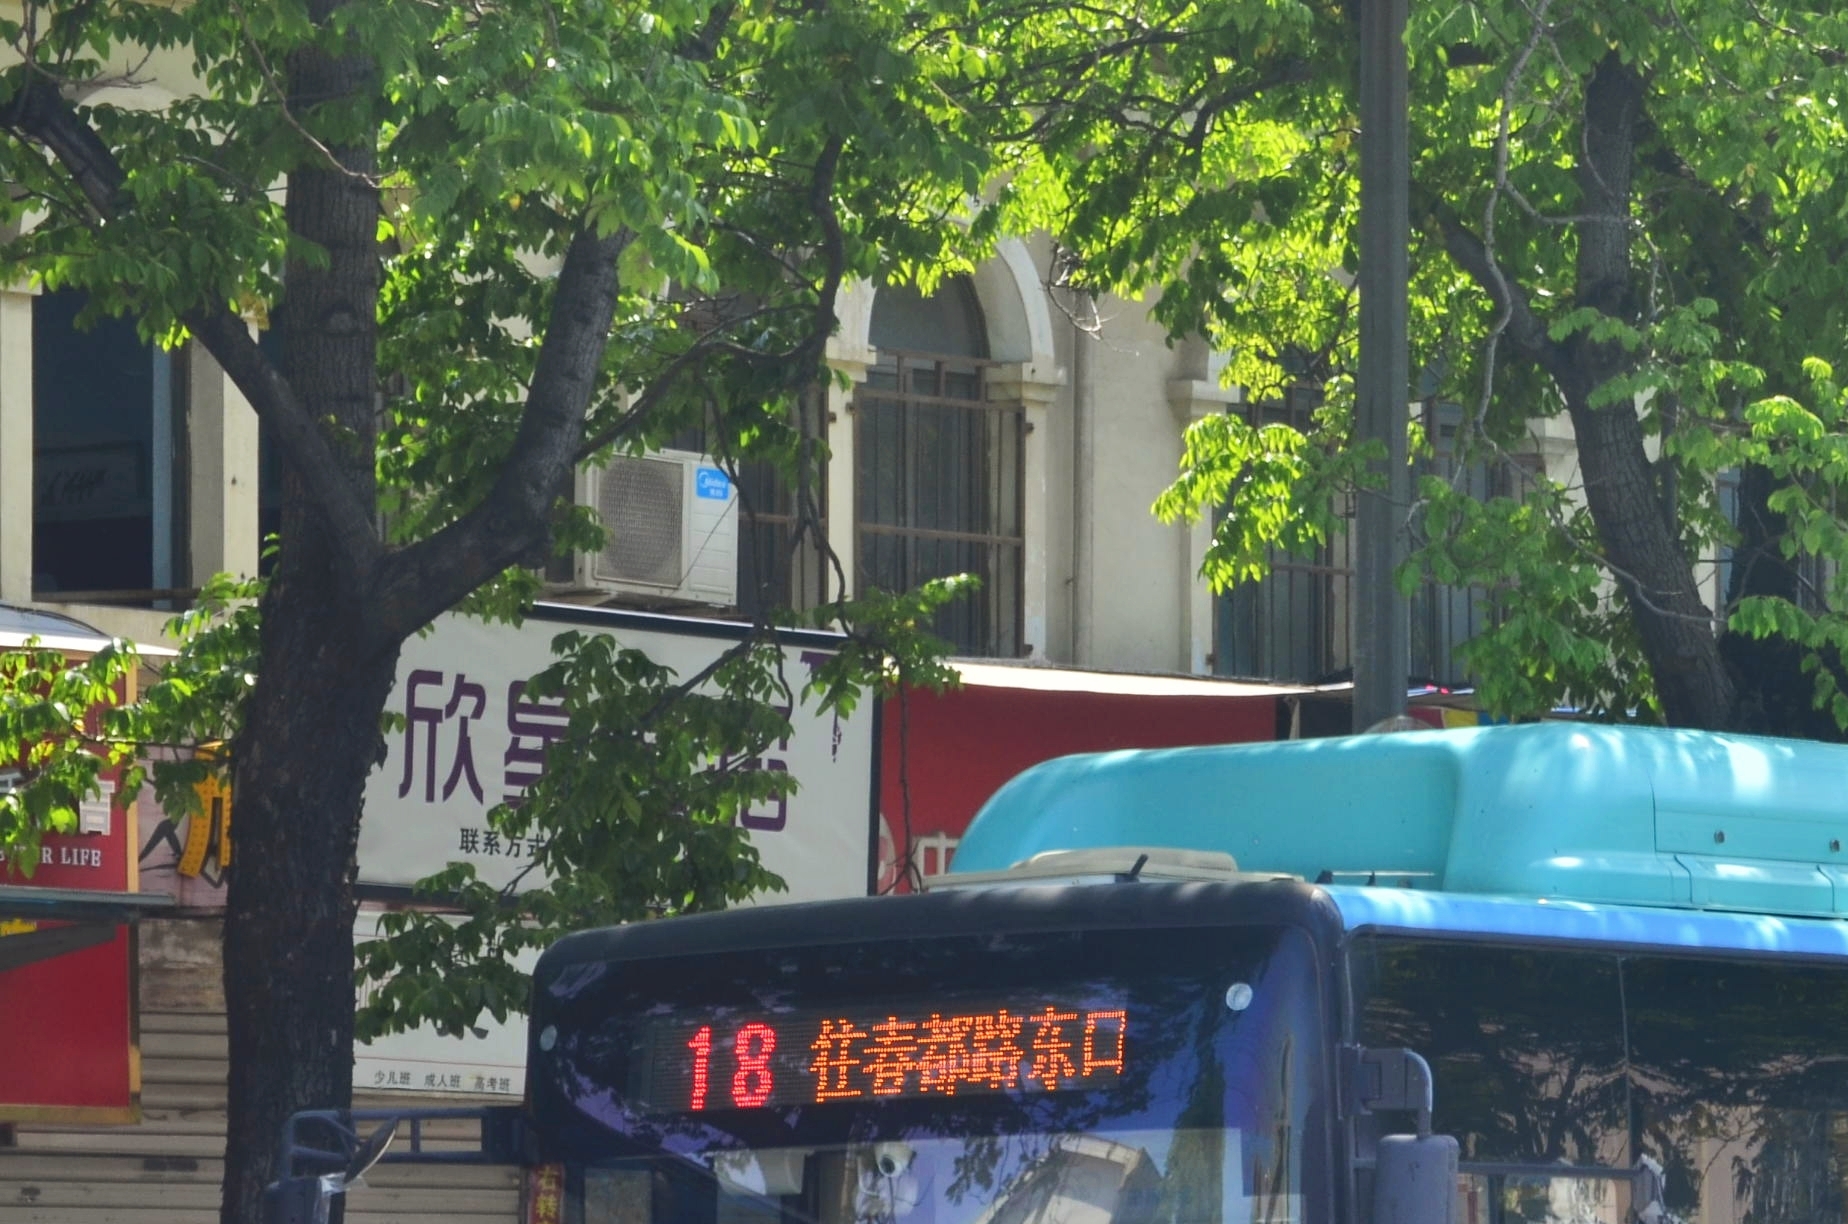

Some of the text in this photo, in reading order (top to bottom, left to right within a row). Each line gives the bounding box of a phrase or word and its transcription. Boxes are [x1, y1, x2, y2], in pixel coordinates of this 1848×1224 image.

[61, 846, 102, 868] LIFE
[688, 1022, 776, 1111] 18
[374, 1070, 510, 1093] 少儿班 成人班 高考班
